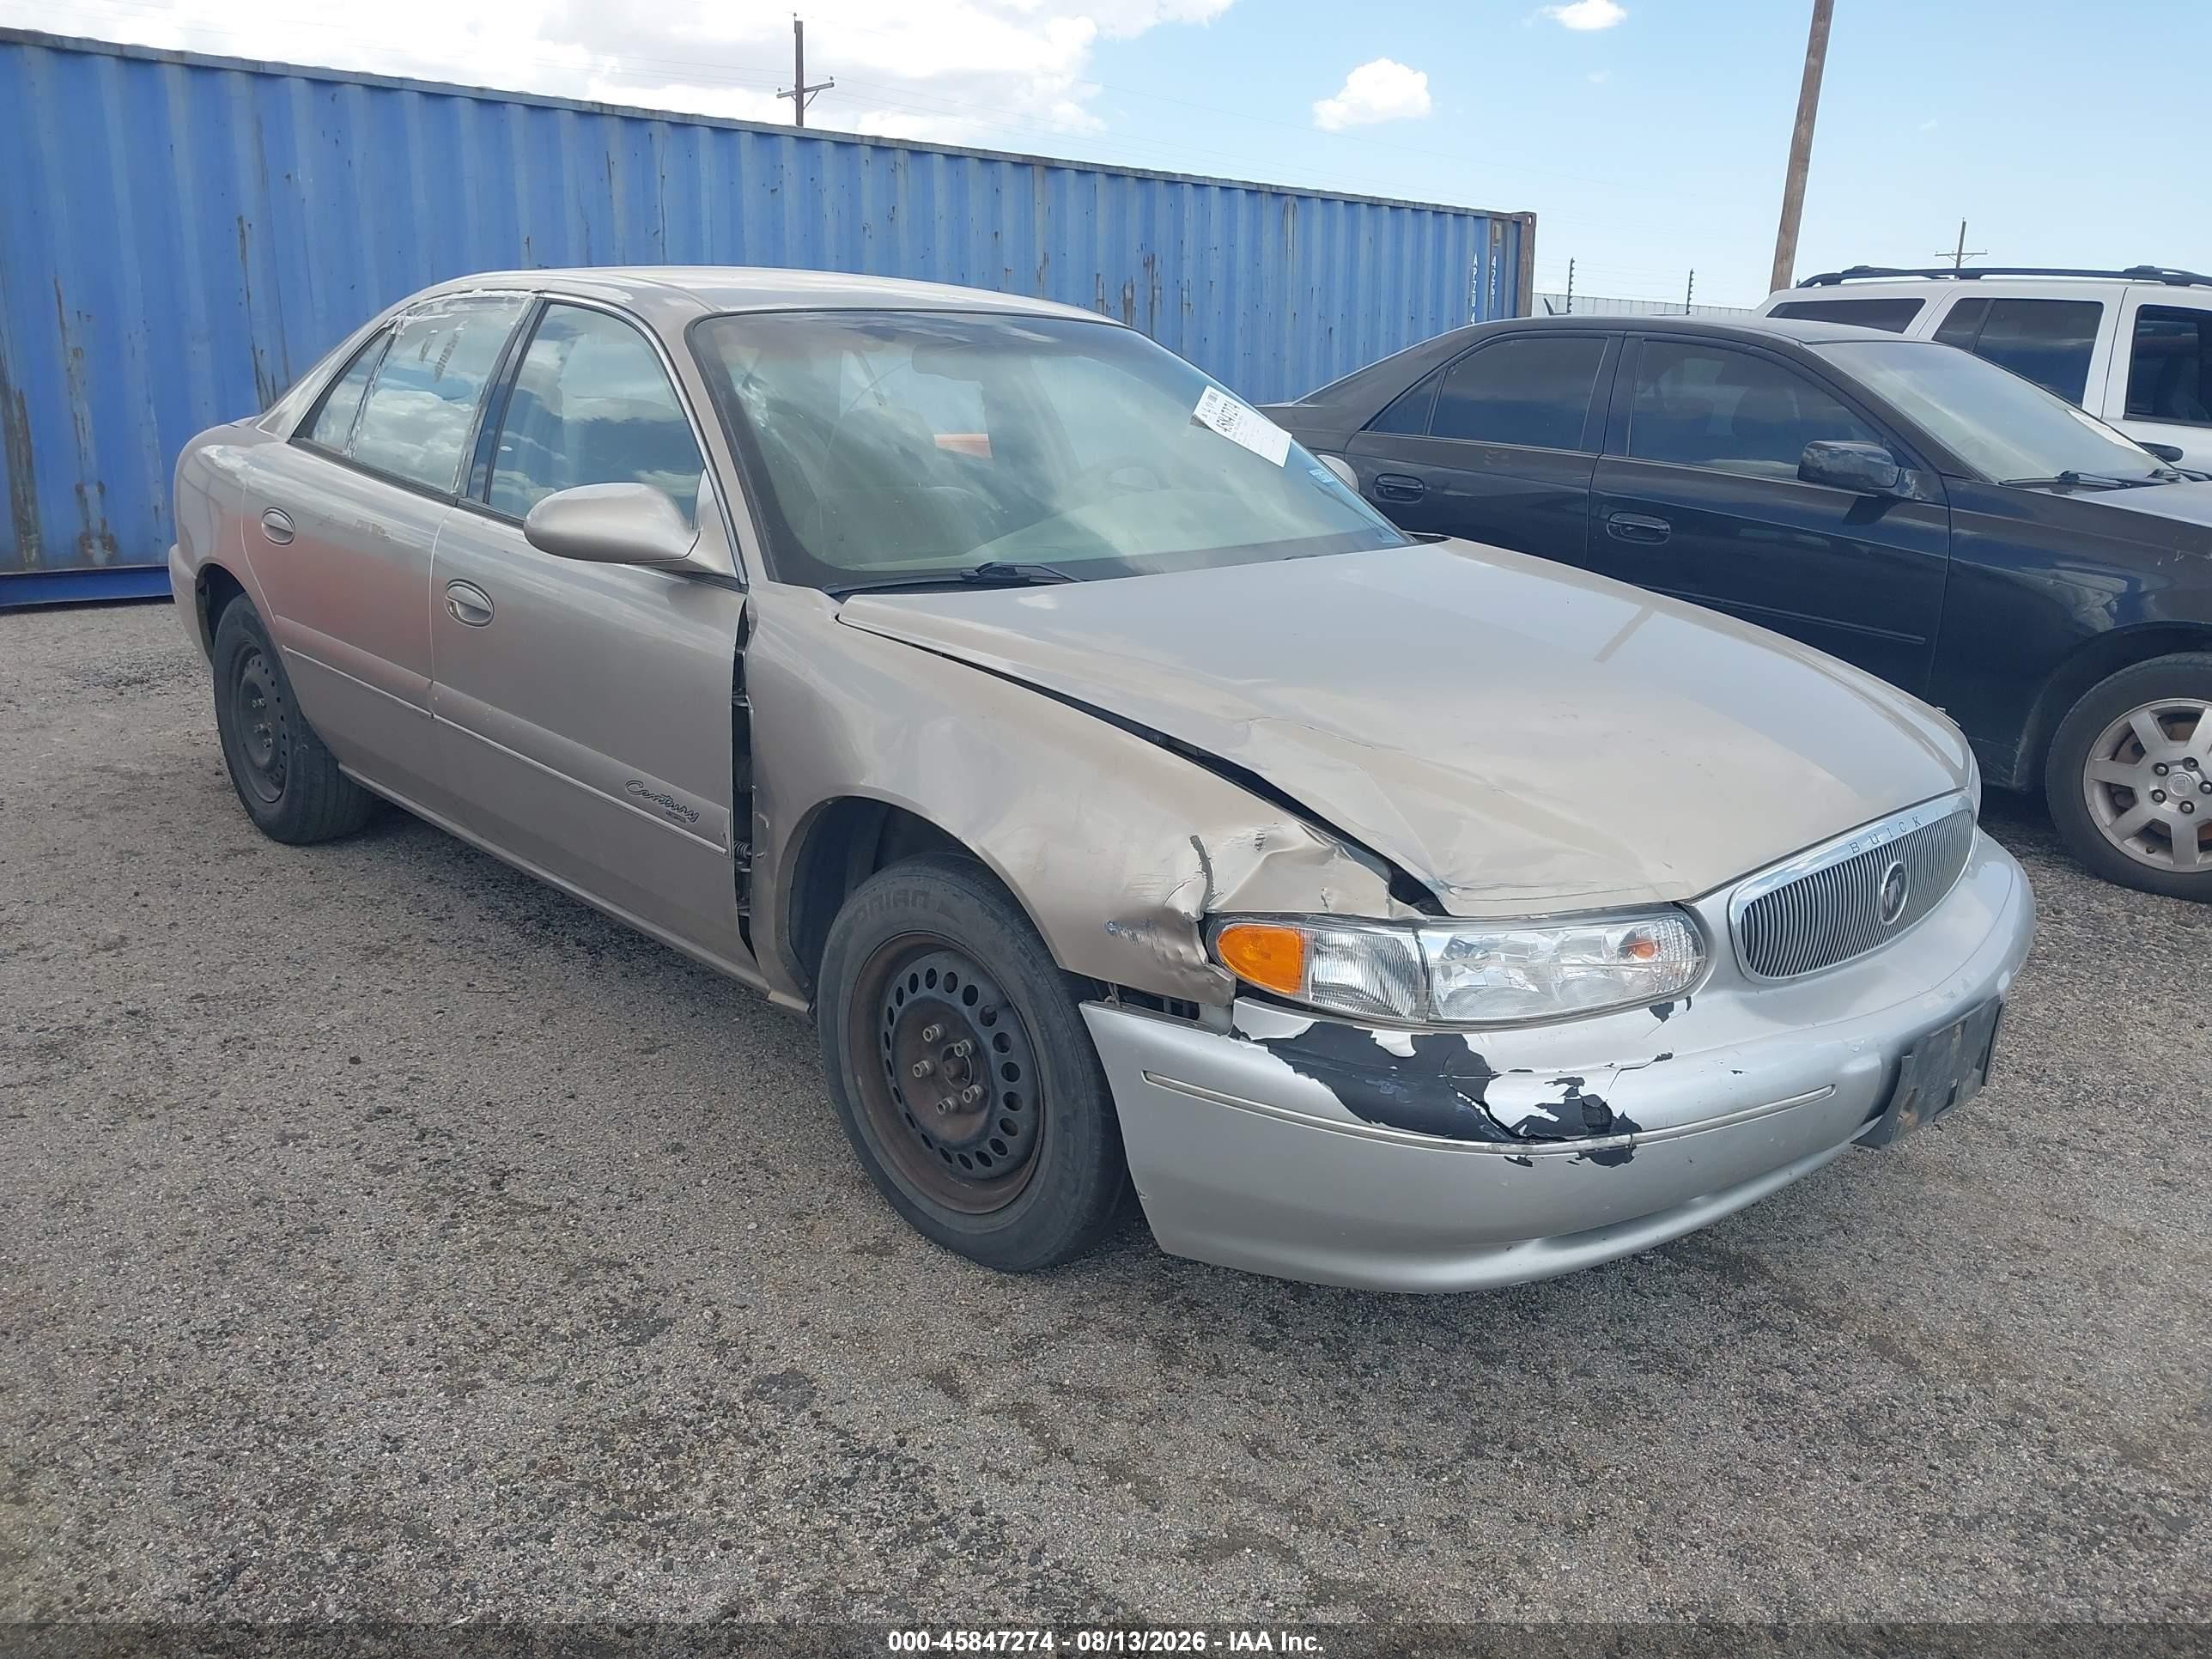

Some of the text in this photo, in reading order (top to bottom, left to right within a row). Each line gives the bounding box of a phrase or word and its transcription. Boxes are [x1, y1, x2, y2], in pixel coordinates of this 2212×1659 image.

[1470, 253, 1479, 307] APZU
[624, 780, 701, 823] Century
[1849, 816, 1923, 854] BUICK
